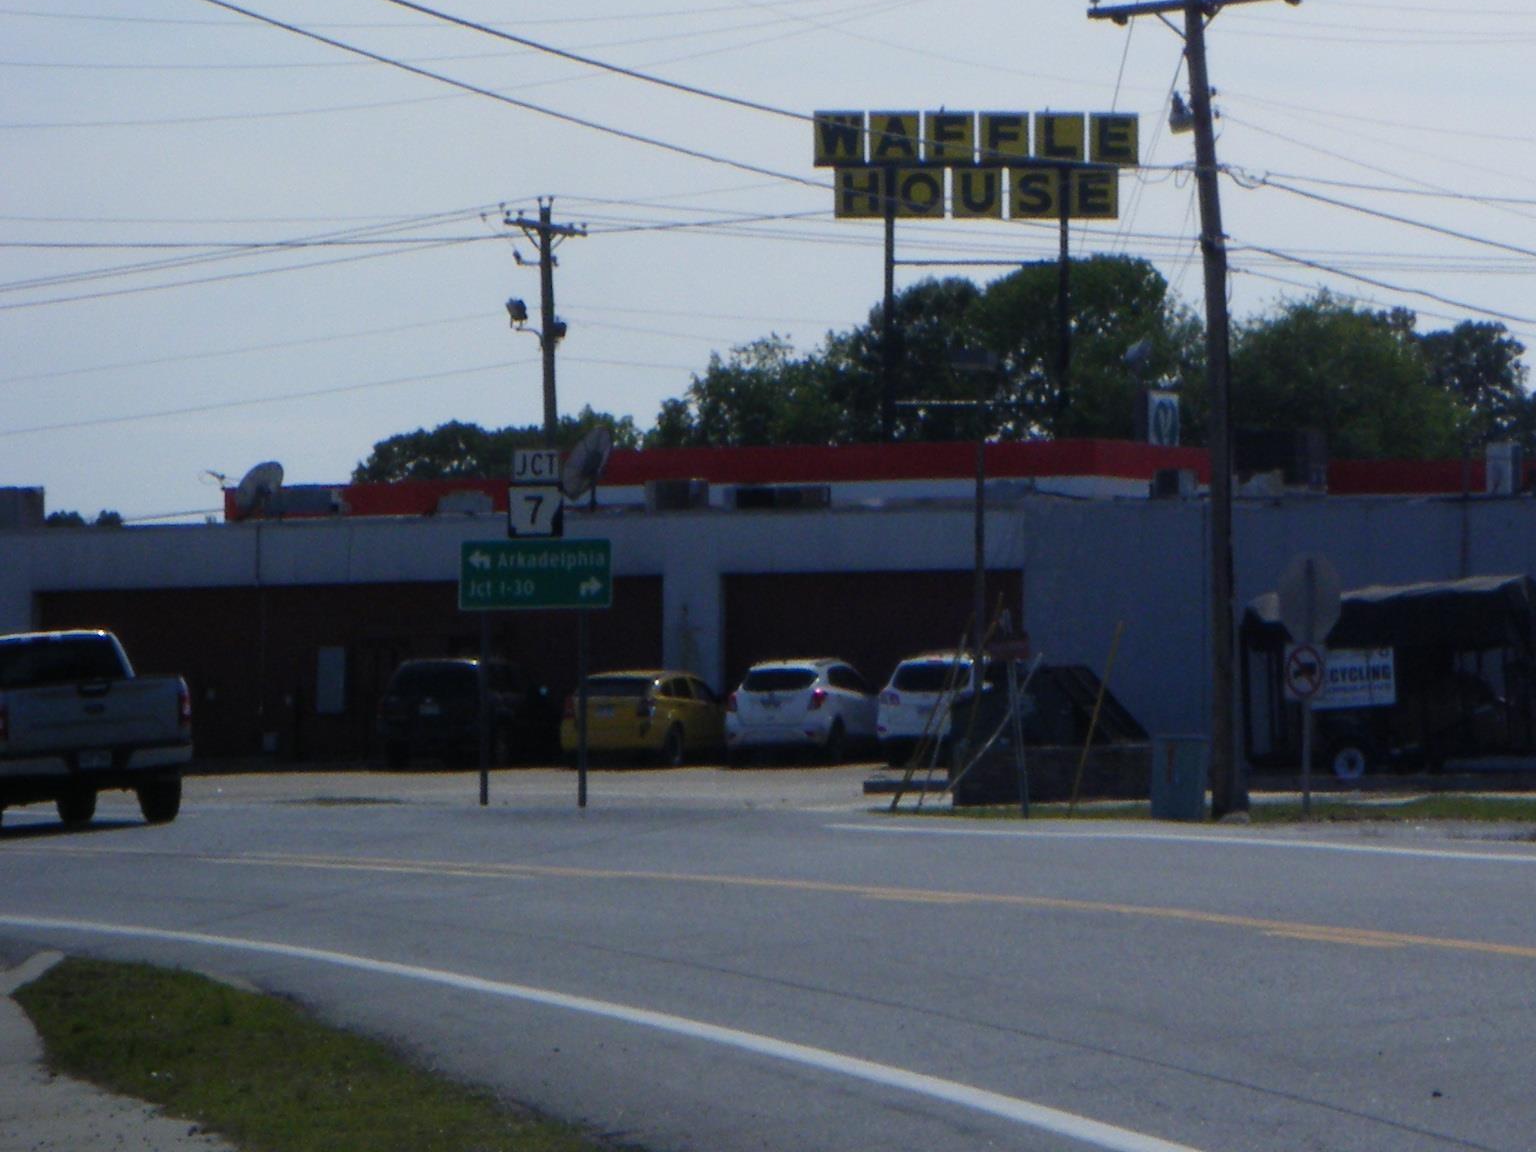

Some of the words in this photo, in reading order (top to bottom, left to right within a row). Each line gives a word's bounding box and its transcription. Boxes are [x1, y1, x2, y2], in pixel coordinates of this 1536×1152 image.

[819, 115, 1132, 156] WAFFLE
[842, 170, 1112, 214] HOUSE
[516, 452, 559, 476] JCT
[525, 495, 544, 526] 7
[498, 550, 606, 571] Arkadelphia
[468, 579, 492, 597] Jct
[1328, 663, 1392, 683] CYCLING
